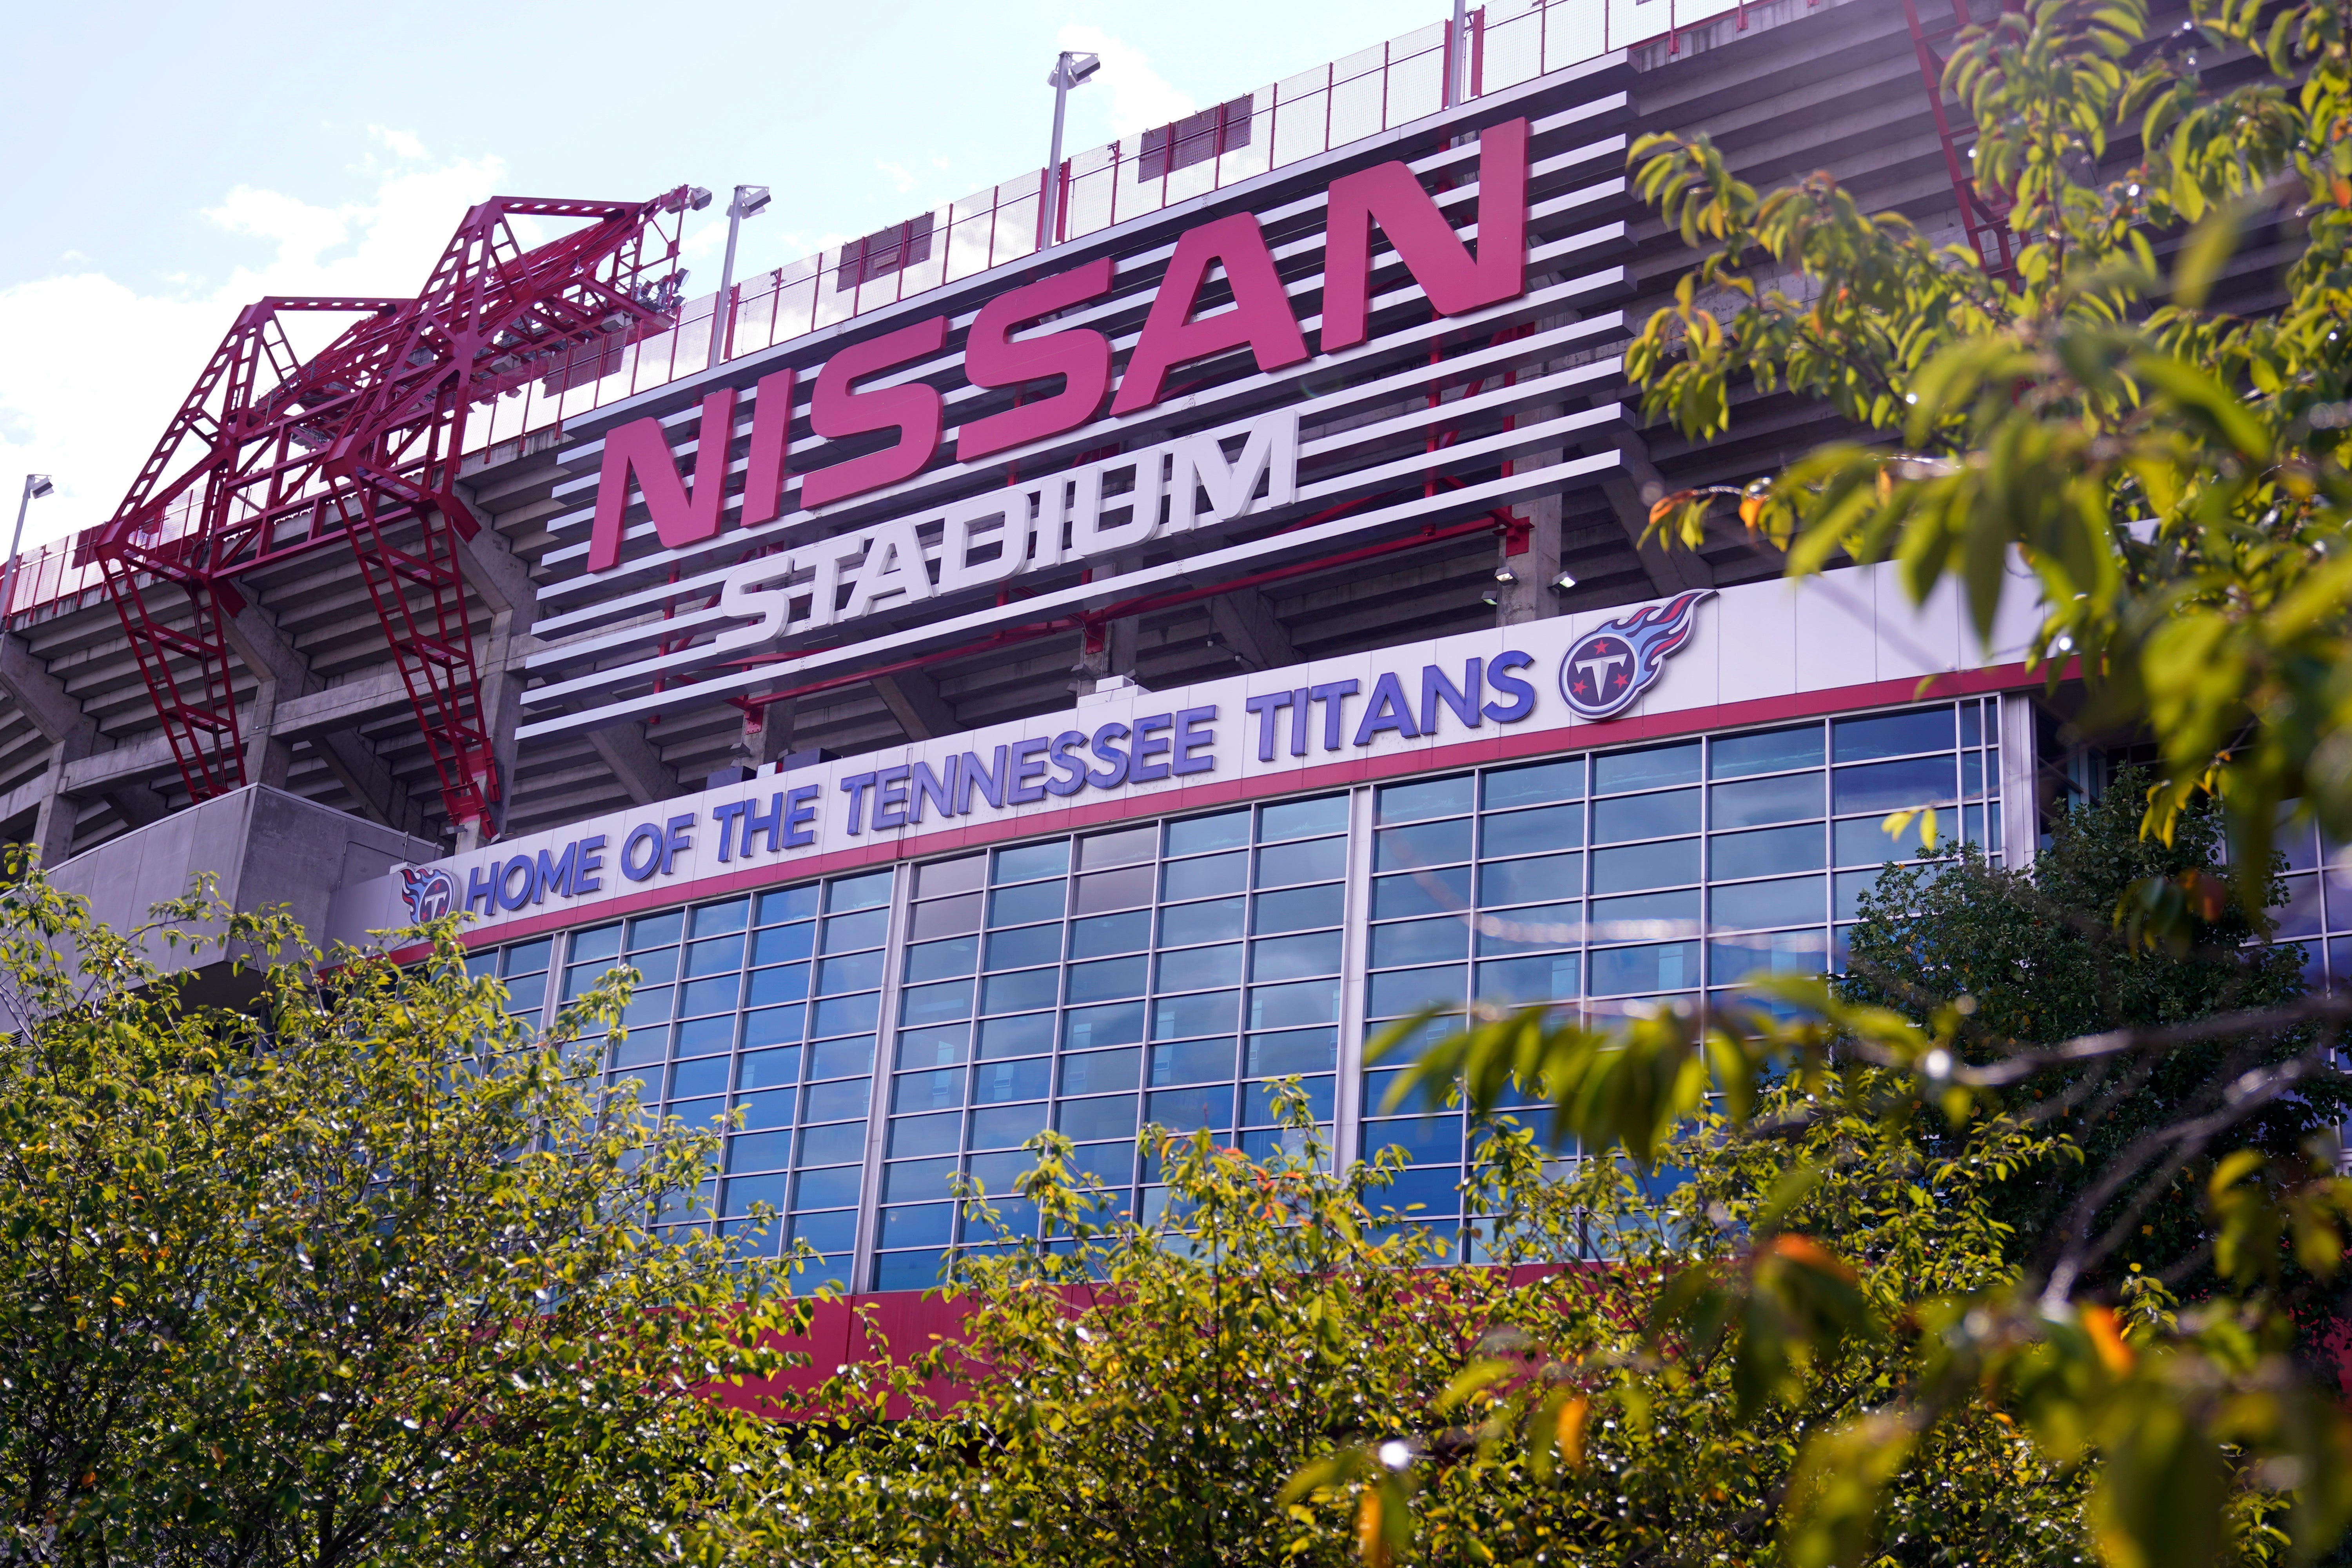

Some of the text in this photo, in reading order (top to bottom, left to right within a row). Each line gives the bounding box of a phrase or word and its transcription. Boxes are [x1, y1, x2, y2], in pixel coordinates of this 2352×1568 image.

[587, 117, 1530, 573] NISSAN
[715, 409, 1299, 655] STADIUM
[465, 650, 1537, 921] HOME OF THE TENNESSEE TITANS
